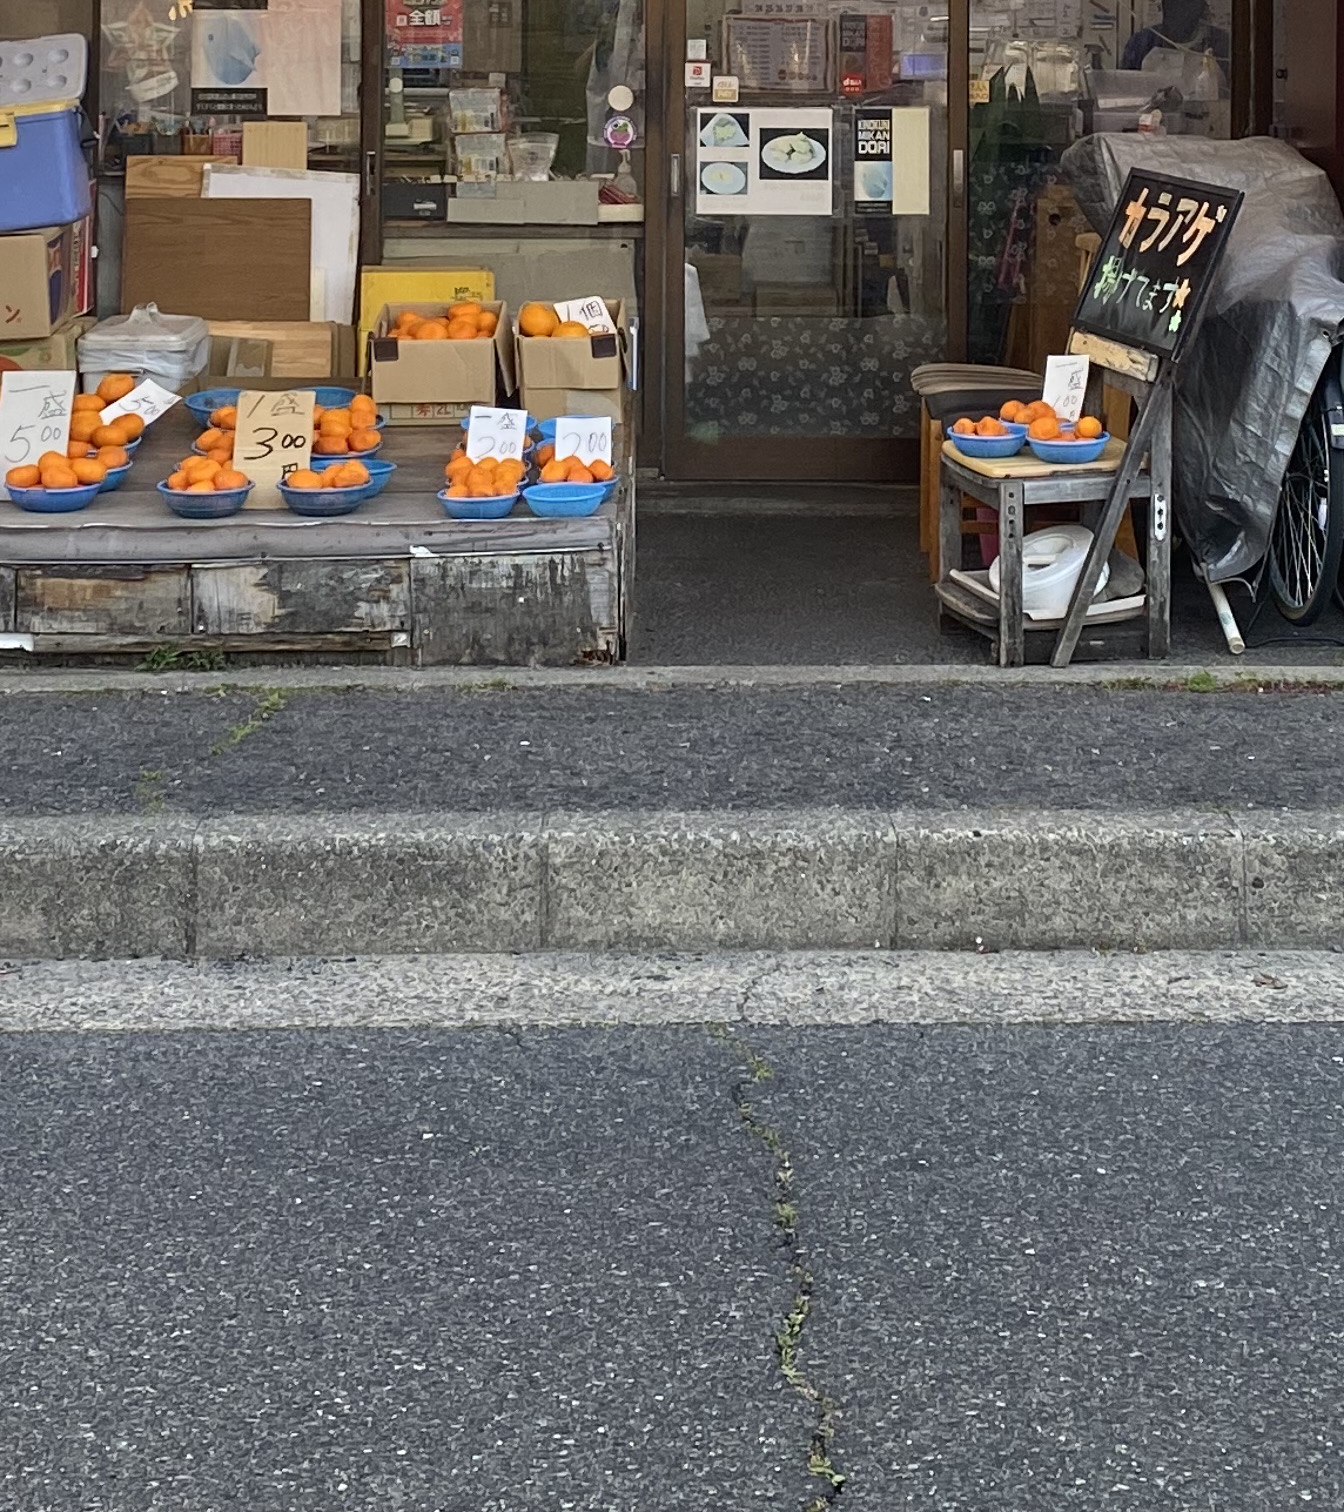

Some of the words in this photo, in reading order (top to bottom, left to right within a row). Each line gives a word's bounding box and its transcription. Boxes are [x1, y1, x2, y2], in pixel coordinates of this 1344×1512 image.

[408, 9, 441, 26] 全額
[1119, 187, 1228, 266] カラアゲ
[4, 425, 62, 463] 500
[244, 427, 306, 460] 300
